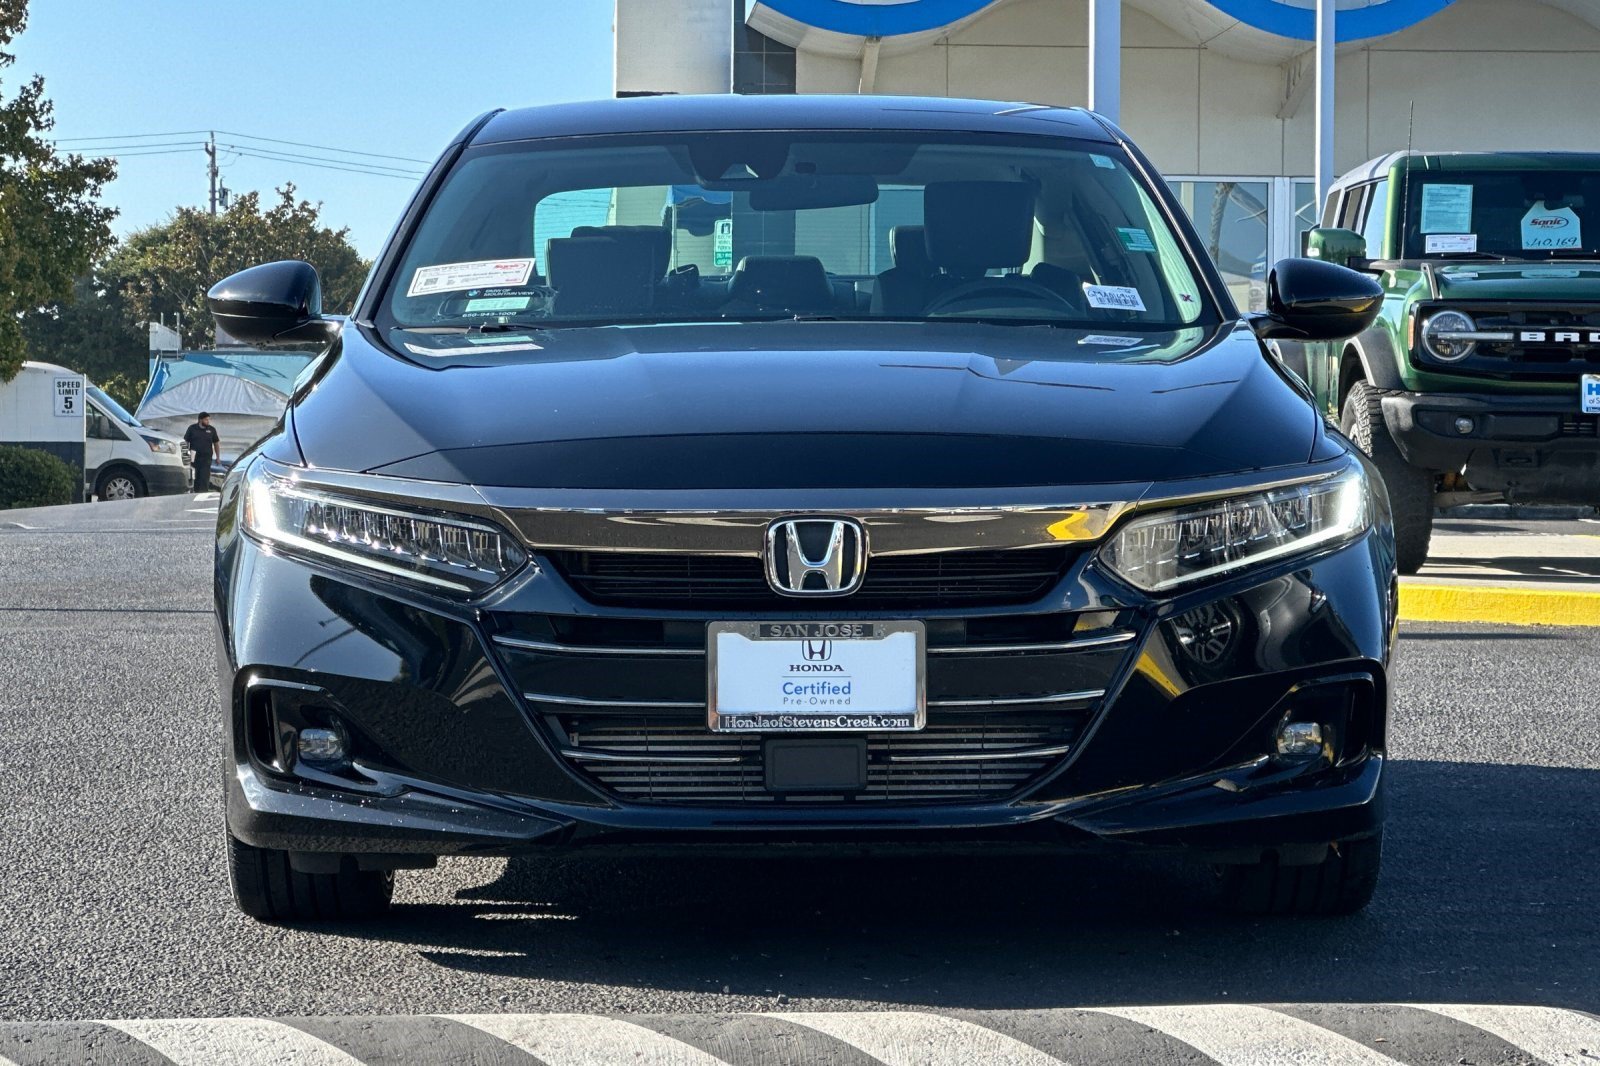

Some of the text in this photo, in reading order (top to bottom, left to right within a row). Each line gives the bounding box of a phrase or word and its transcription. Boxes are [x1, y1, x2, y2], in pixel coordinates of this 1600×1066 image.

[1530, 217, 1564, 226] Sonic
[64, 396, 73, 410] 5
[770, 624, 864, 637] SAN JOSE
[789, 664, 844, 672] HONDA
[782, 681, 851, 695] Certified
[783, 697, 851, 705] Pre-Owned
[724, 715, 910, 729] HondaofStevensCreek.com
